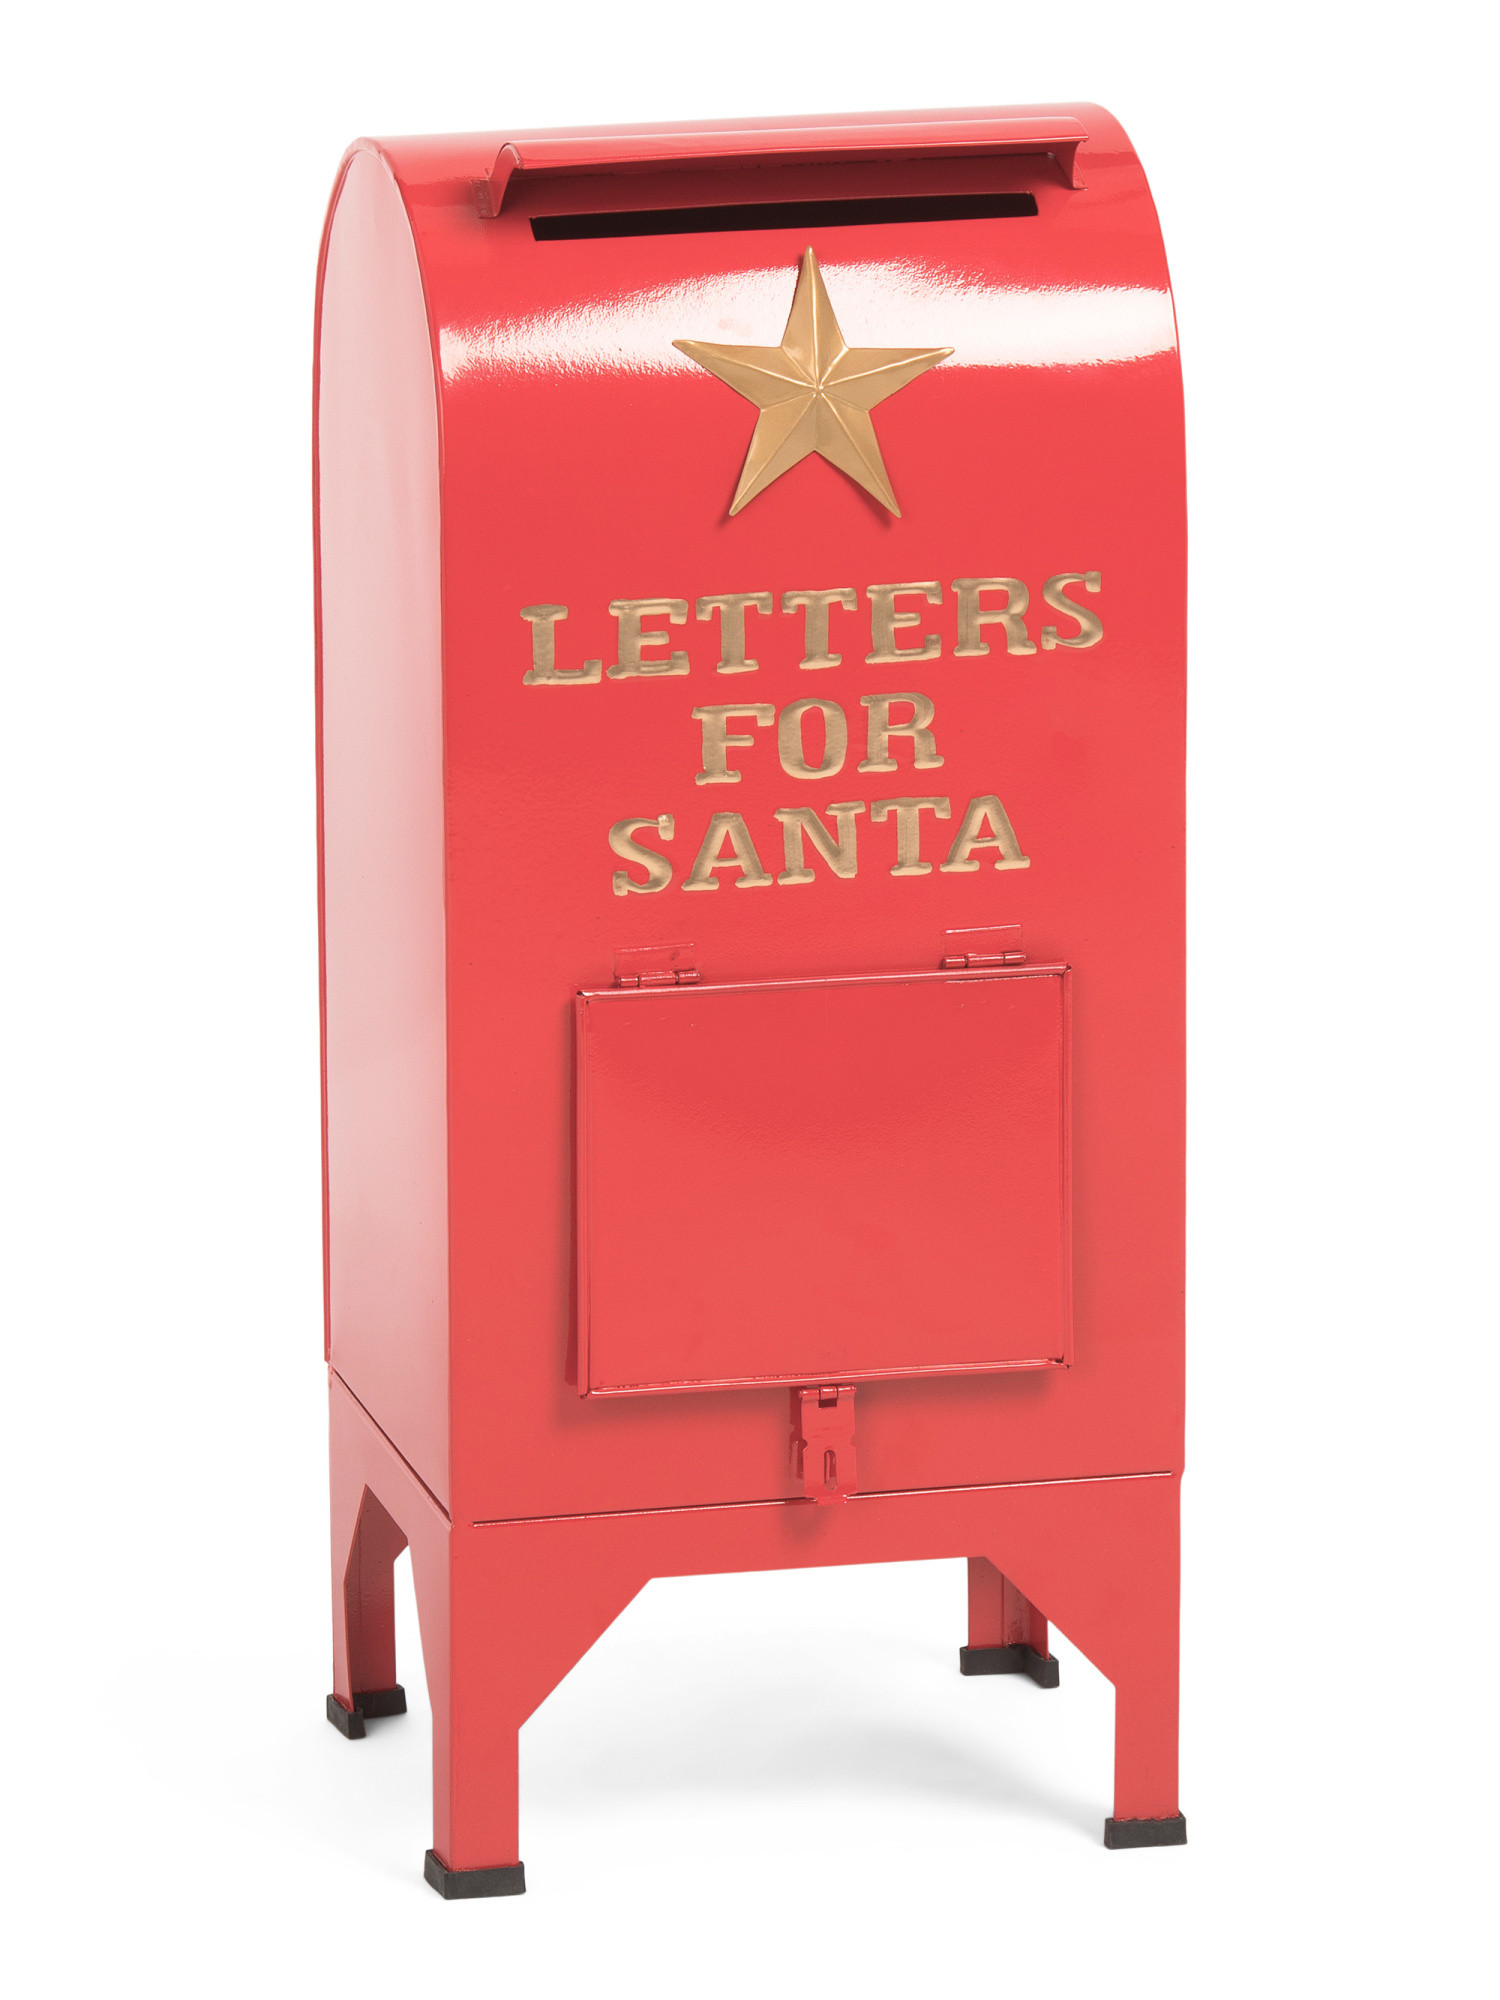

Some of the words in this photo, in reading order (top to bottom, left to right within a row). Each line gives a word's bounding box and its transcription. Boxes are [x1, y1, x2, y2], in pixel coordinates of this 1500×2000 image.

[519, 571, 1104, 686] LETTERS
[691, 692, 945, 786] FOR
[608, 795, 1031, 897] SANTA
